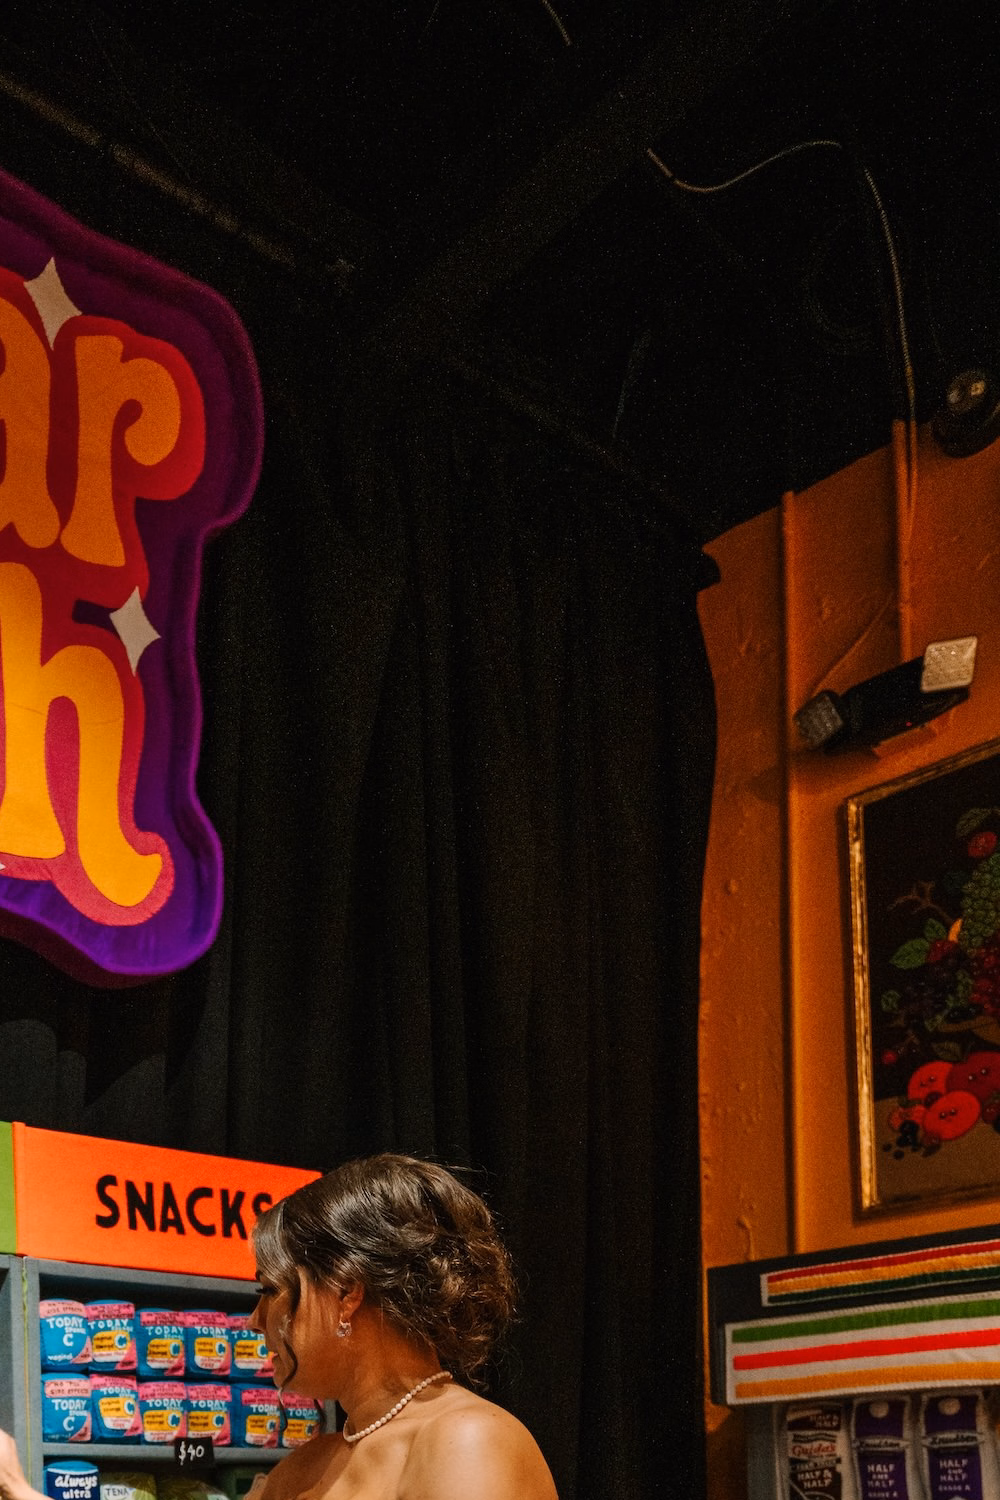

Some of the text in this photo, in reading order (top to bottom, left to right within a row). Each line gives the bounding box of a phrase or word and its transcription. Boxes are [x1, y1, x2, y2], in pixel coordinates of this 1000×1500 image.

[46, 1317, 84, 1329] TODAY
[88, 1319, 129, 1330] TODAY
[146, 1325, 184, 1336] TODAY
[194, 1325, 227, 1336] TODAY
[63, 1333, 74, 1347] C
[100, 1387, 132, 1395] TODAY
[51, 1399, 87, 1411] TODAY
[146, 1398, 183, 1408] TODAY
[190, 1400, 226, 1409] TODAY
[251, 1404, 279, 1413] TODAY
[288, 1408, 318, 1417] TODAY
[63, 1416, 75, 1431] C
[178, 1440, 205, 1466] $40
[867, 1464, 895, 1473] HALF
[940, 1459, 968, 1469] HALF
[55, 1475, 98, 1489] always
[798, 1472, 821, 1481] HALF
[940, 1474, 968, 1482] HALF
[803, 1479, 831, 1489] HALF
[62, 1489, 91, 1500] ultra
[104, 1487, 130, 1498] TENA
